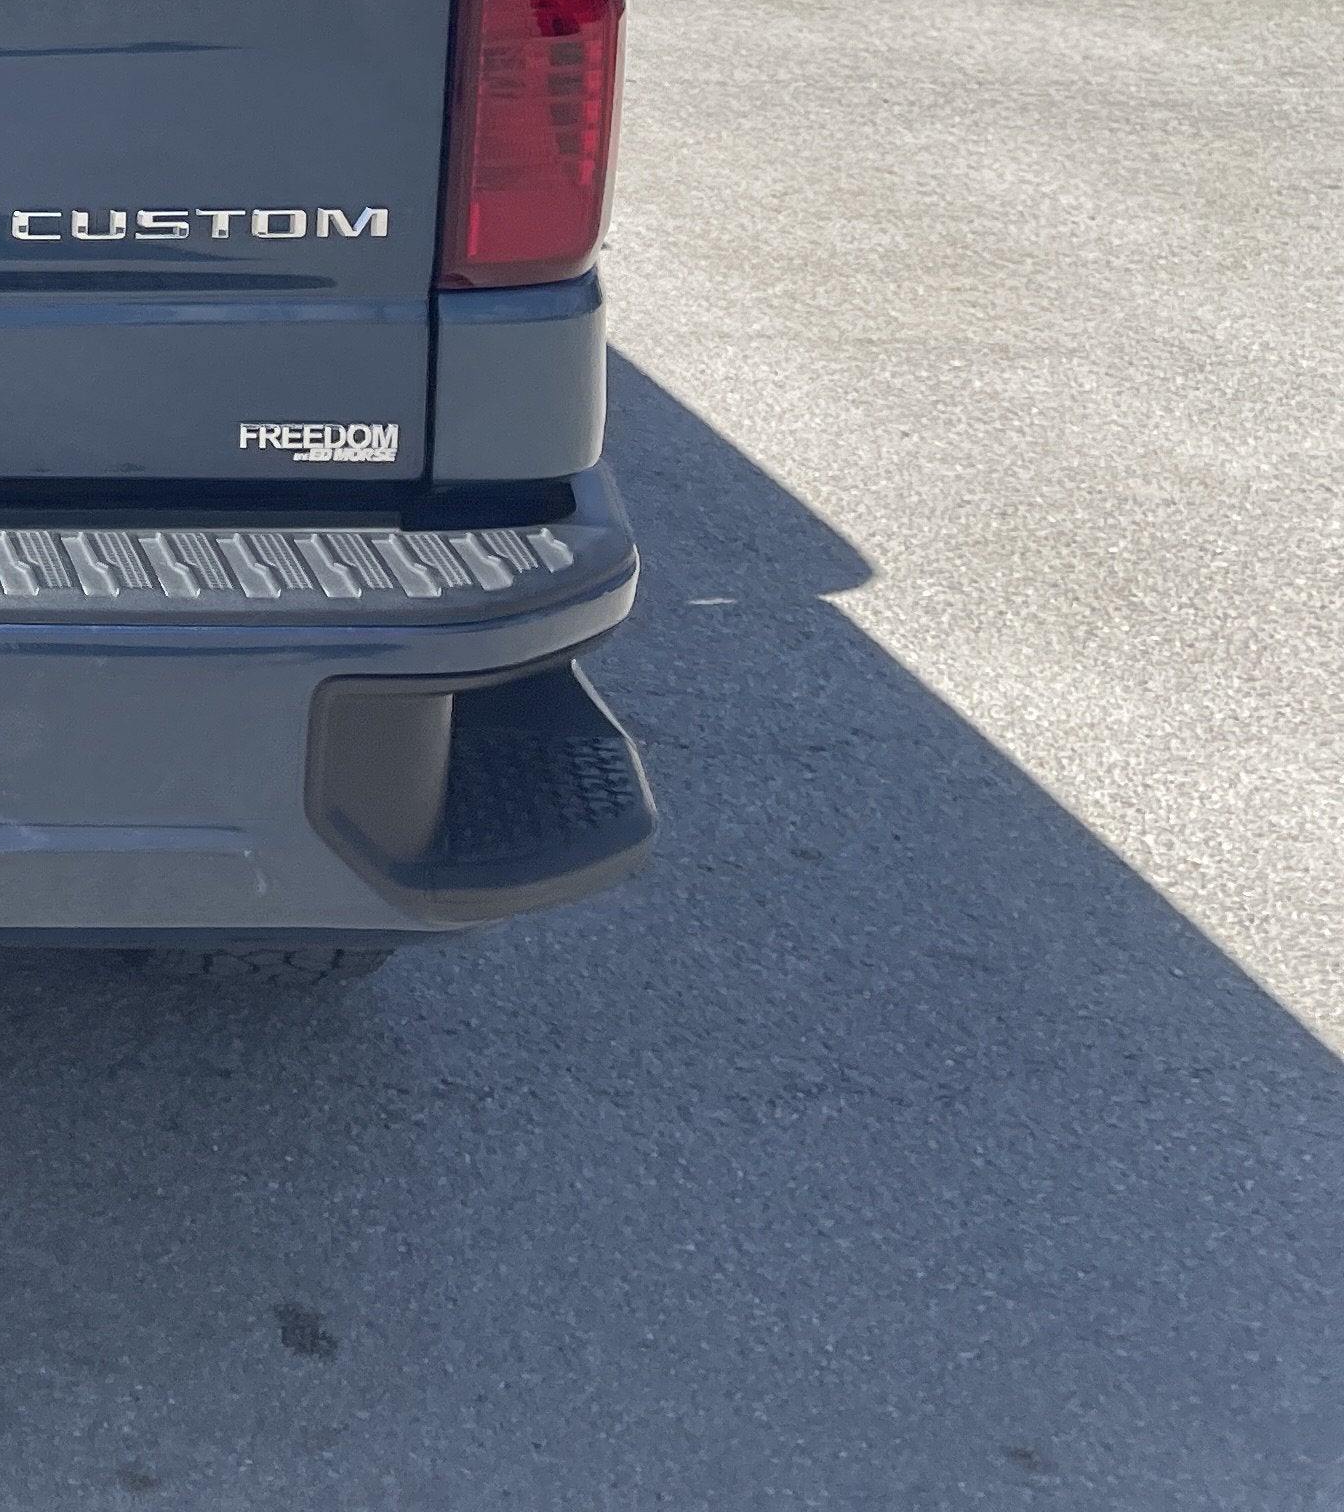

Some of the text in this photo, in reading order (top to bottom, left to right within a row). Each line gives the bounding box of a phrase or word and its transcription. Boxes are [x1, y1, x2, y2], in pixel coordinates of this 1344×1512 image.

[12, 206, 389, 240] CUSTOM
[239, 423, 399, 449] FREEDOM
[333, 449, 397, 462] MORSE
